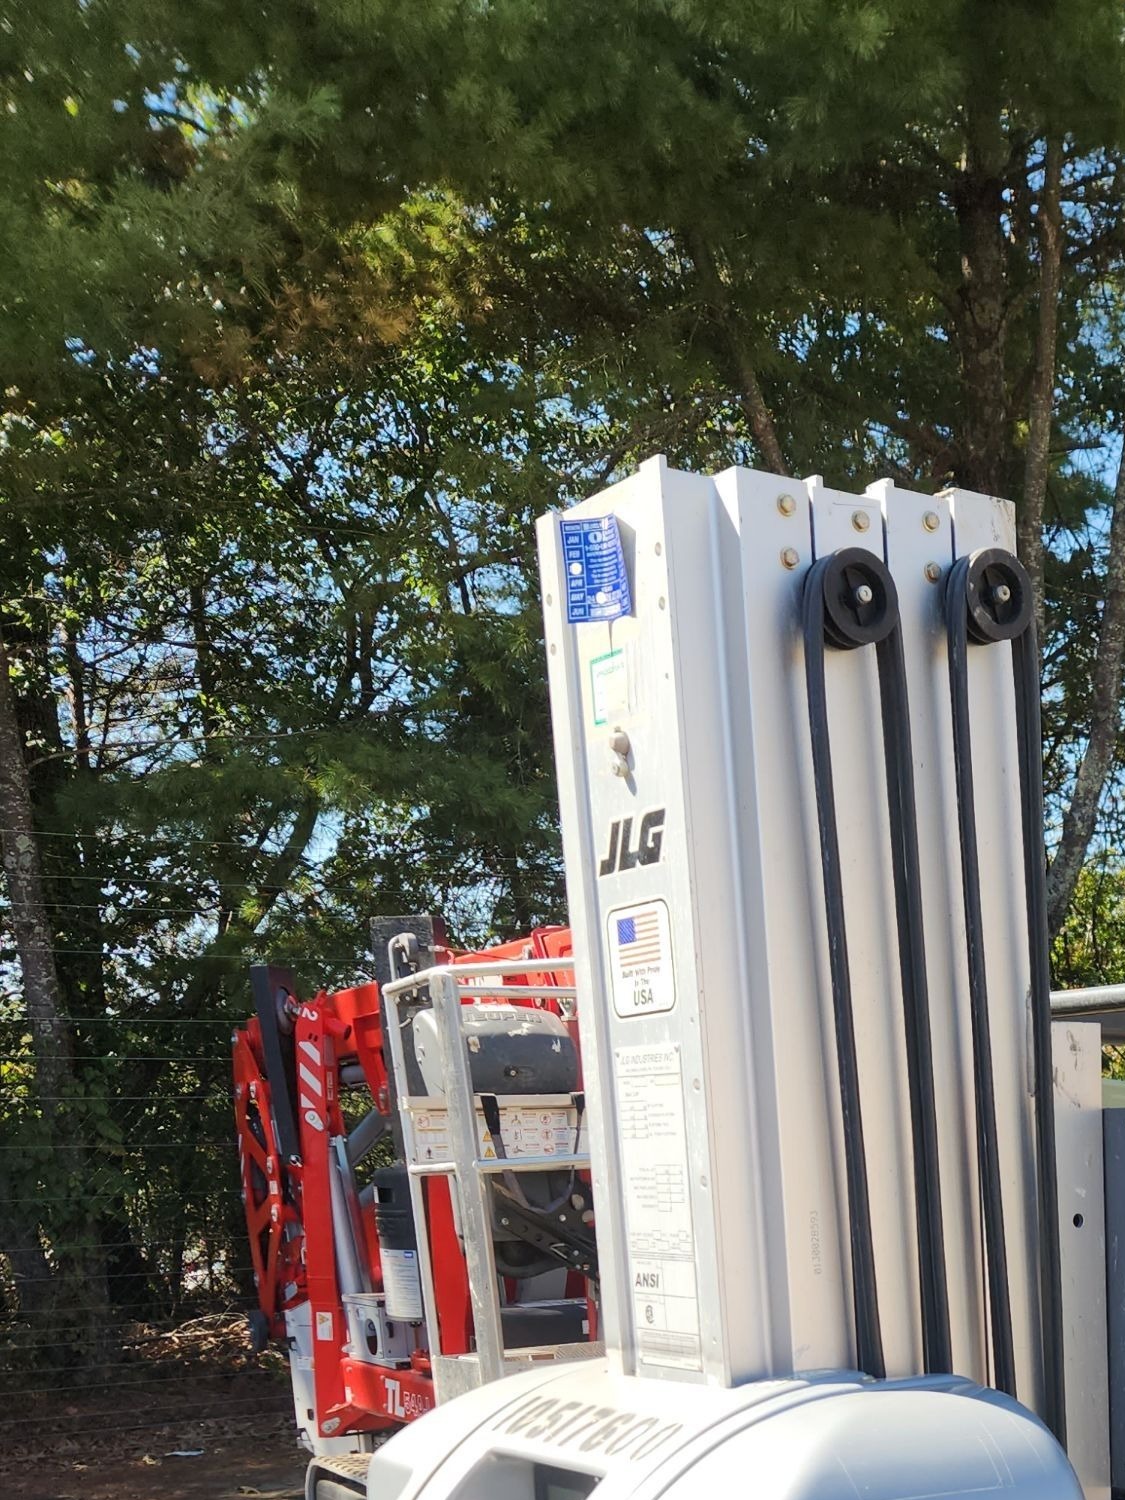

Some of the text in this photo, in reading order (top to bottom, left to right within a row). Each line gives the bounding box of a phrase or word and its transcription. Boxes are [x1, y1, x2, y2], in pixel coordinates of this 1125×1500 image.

[599, 808, 666, 877] JLG
[633, 987, 654, 1006] USA
[635, 1272, 660, 1288] ANSI
